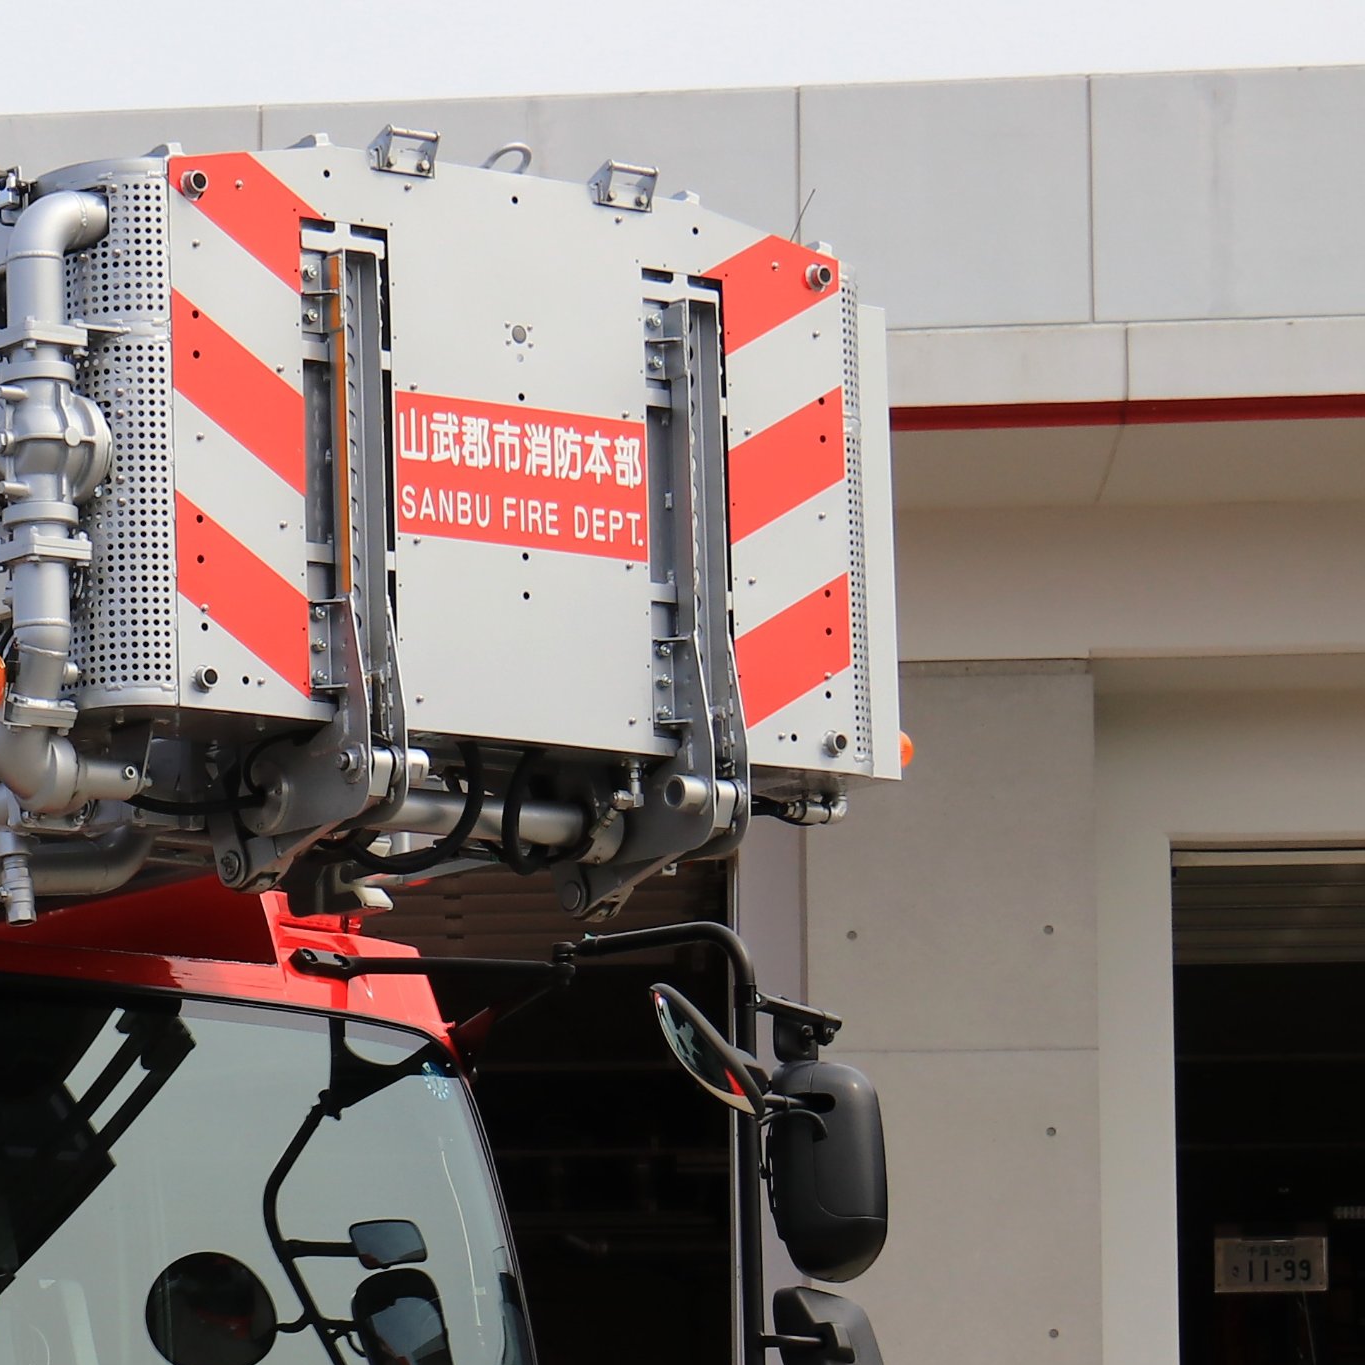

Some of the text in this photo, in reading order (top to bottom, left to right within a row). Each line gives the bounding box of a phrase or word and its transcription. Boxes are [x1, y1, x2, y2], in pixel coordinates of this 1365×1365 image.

[398, 407, 643, 490] 山武郡市消防本部
[400, 484, 644, 547] SANBU FIRE DEPT.
